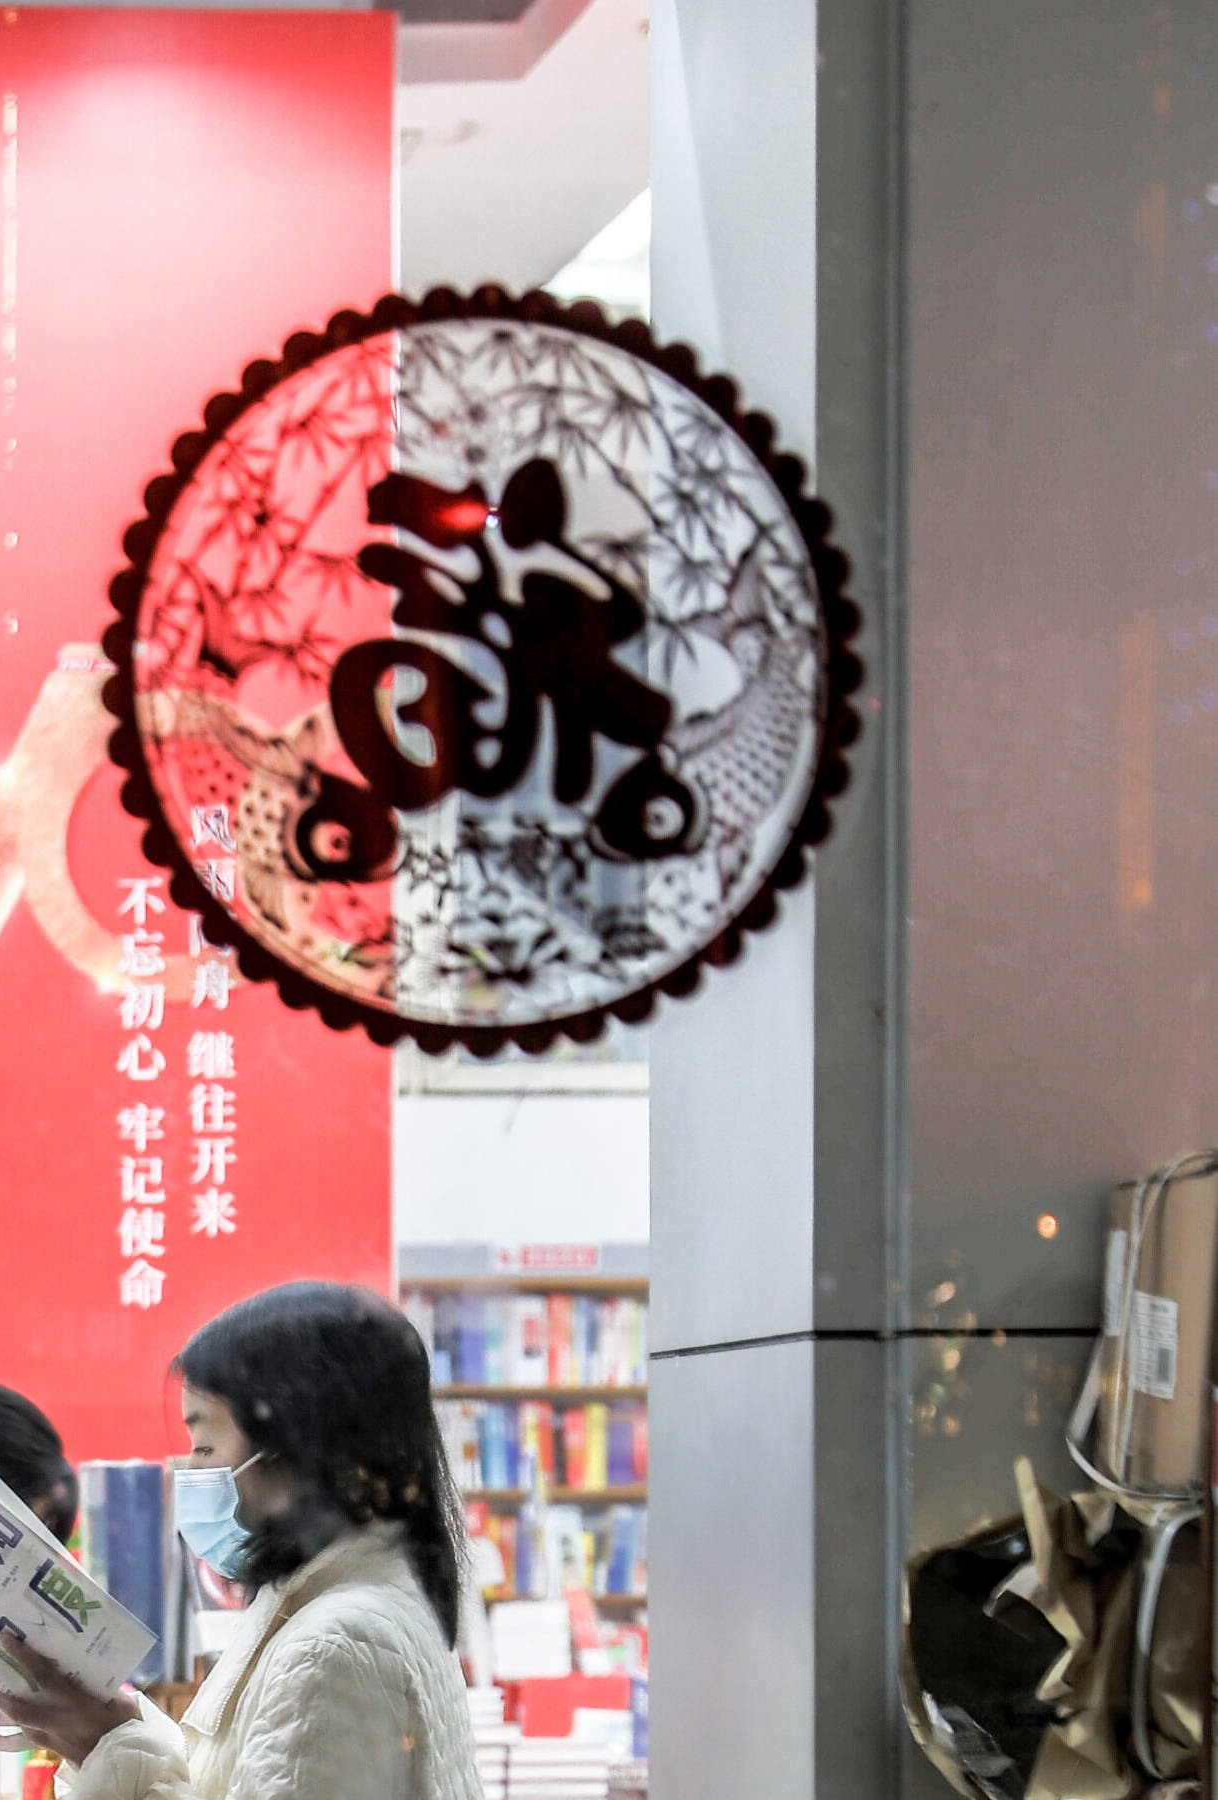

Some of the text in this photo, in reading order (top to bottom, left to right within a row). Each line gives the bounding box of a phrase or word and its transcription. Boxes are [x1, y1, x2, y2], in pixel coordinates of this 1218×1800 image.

[116, 875, 166, 1310] 不忘初心 牢记使命
[186, 1031, 237, 1238] 继往开来
